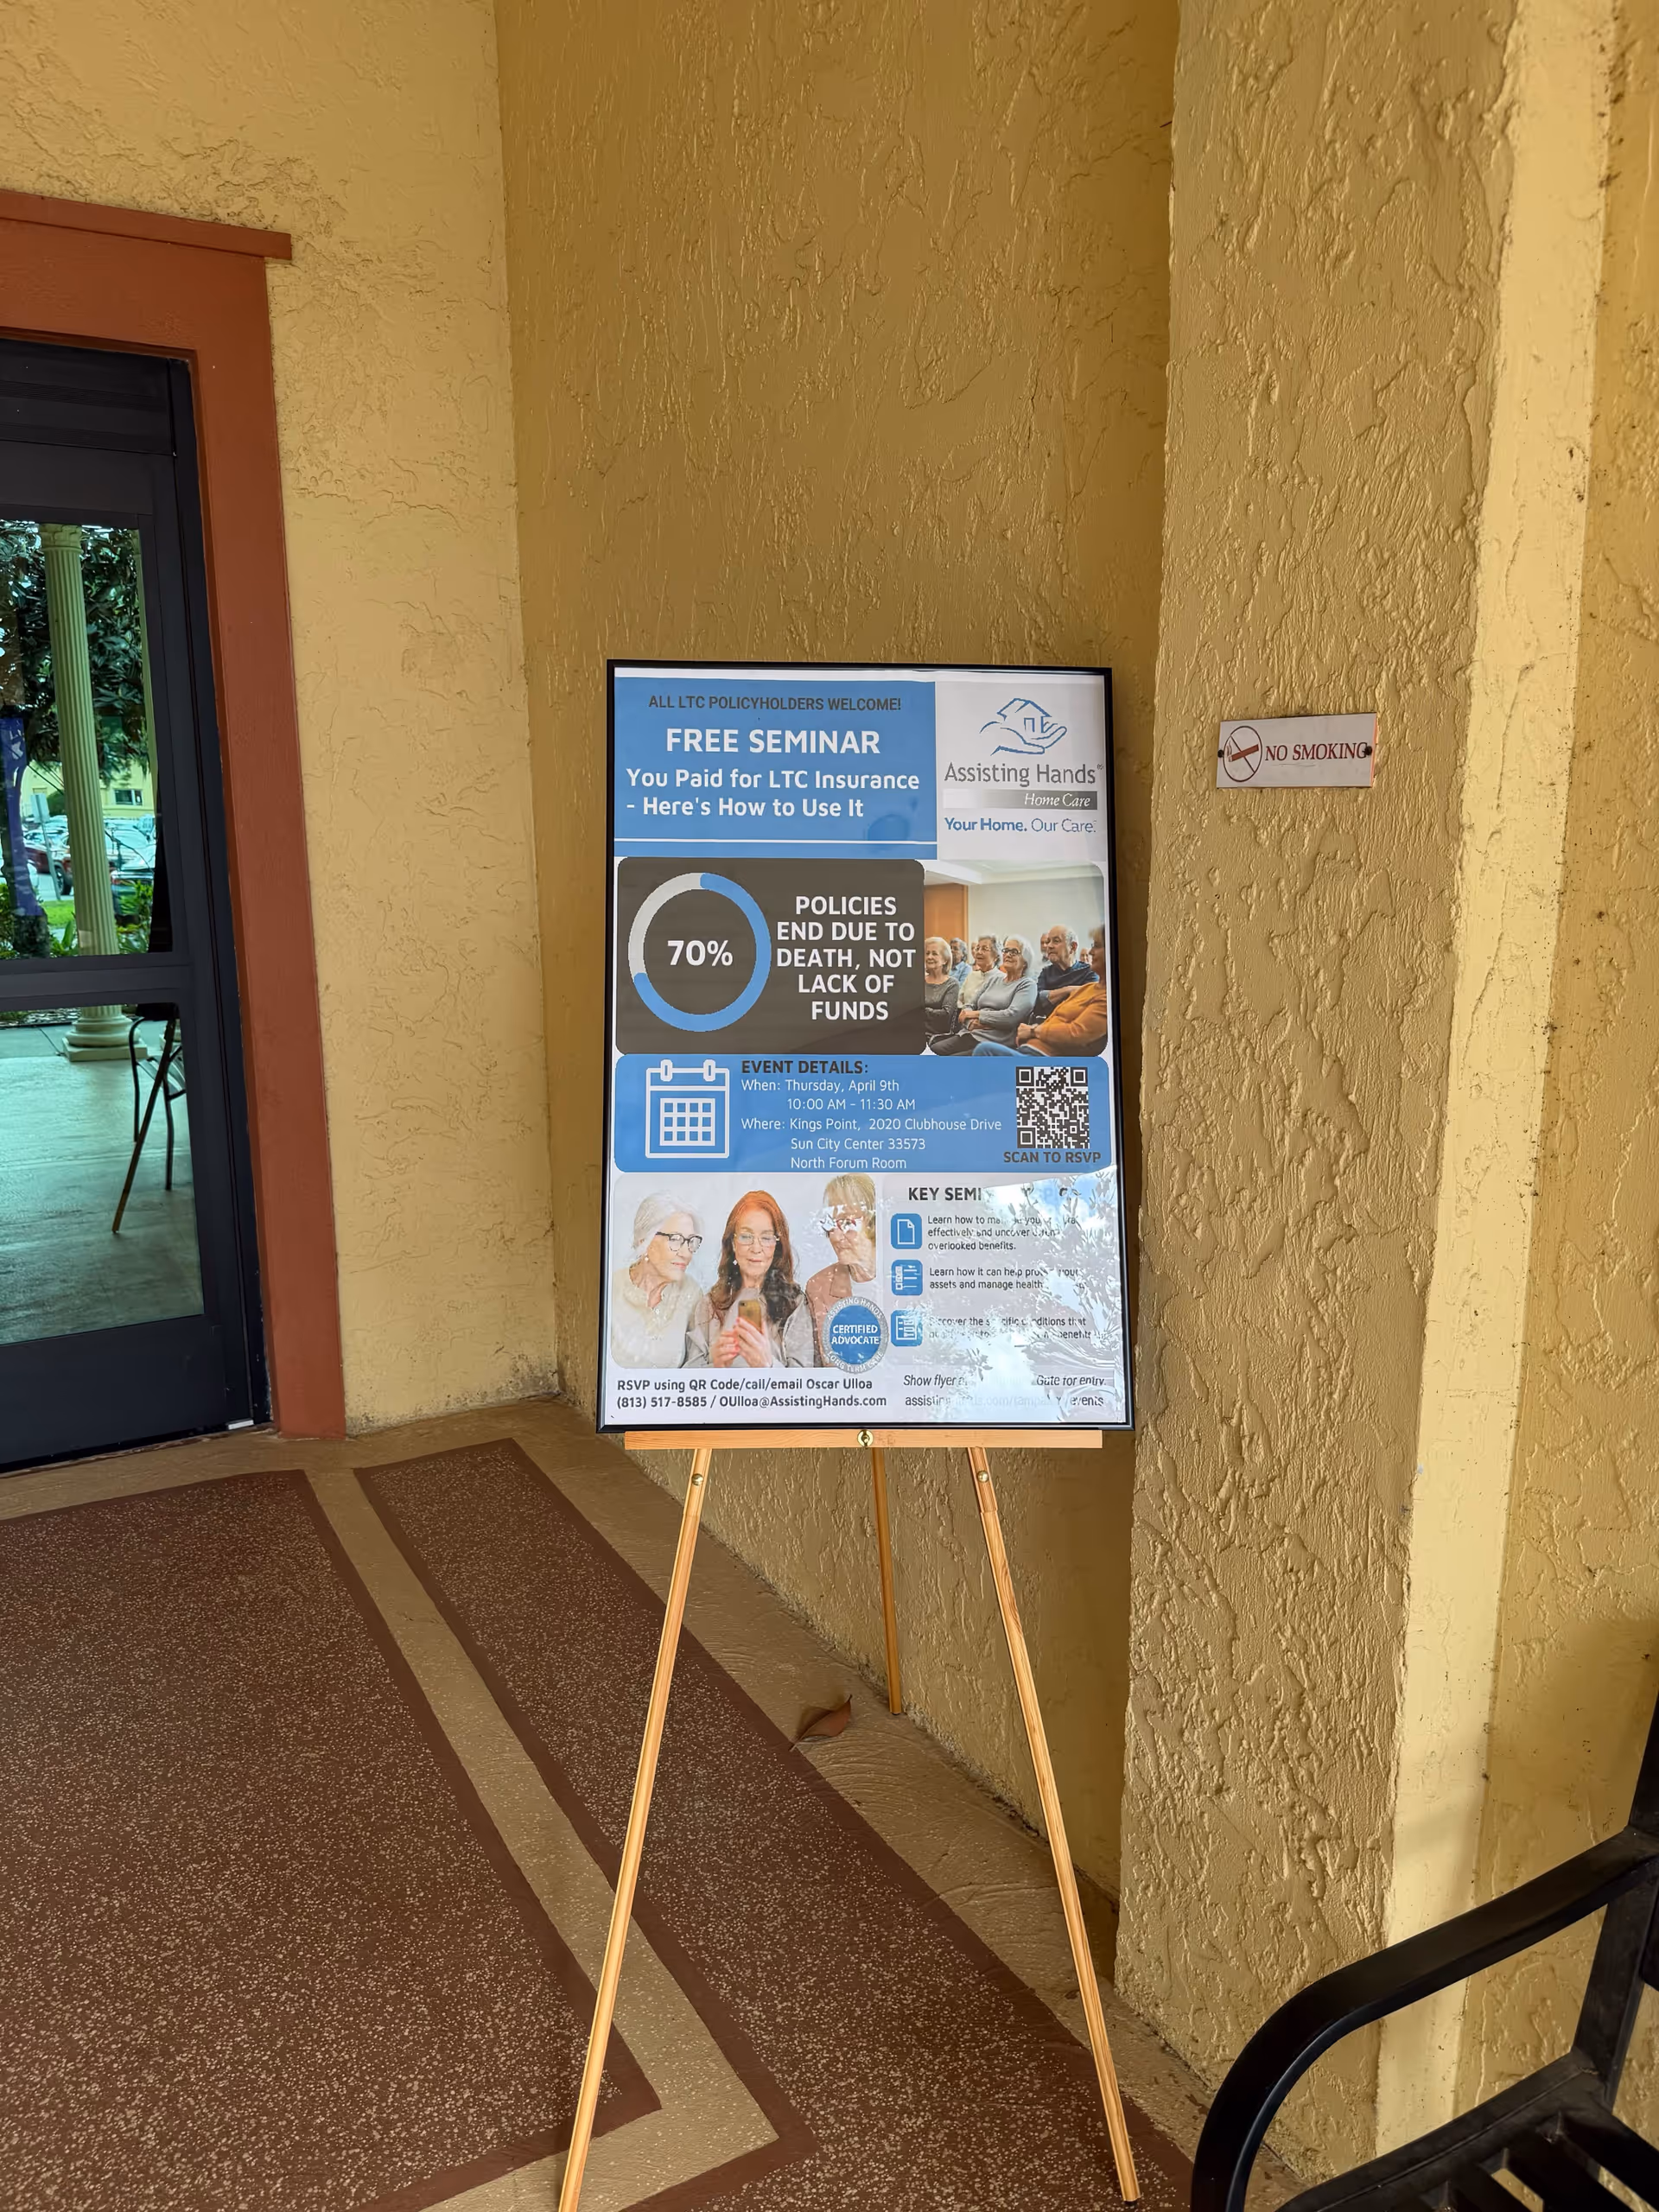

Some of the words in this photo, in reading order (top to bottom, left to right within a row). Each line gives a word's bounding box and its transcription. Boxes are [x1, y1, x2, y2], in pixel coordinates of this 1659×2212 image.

[649, 696, 678, 709] ALL
[681, 696, 705, 709] LTC
[709, 696, 824, 710] POLICYHOLDERS
[828, 697, 901, 711] WELCOME!
[666, 728, 739, 753] FREE
[749, 730, 880, 754] SEMINAR
[1265, 745, 1287, 760] NO
[1293, 742, 1368, 760] SMOKING
[626, 769, 670, 787] You
[676, 770, 723, 788] Paid
[729, 770, 761, 788] for
[768, 771, 808, 789] LTC
[816, 772, 919, 790] Insurance
[944, 762, 1030, 787] Assisting
[1025, 793, 1059, 806] Home
[1063, 793, 1090, 807] Care
[643, 798, 711, 816] Here's
[719, 798, 766, 817] How
[773, 800, 794, 817] to
[803, 799, 842, 817] Use
[849, 799, 863, 817] It
[944, 817, 977, 830] Your
[980, 818, 1027, 831] Home.
[1032, 818, 1058, 831] Our
[796, 896, 897, 915] POLICIES
[778, 922, 824, 941] END
[831, 923, 878, 941] DUE
[885, 923, 915, 941] TO
[667, 940, 734, 967] 70%
[778, 949, 861, 970] DEATH,
[869, 950, 916, 968] NOT
[798, 975, 857, 994] LACK
[865, 975, 894, 994] OF
[812, 1001, 888, 1020] FUNDS
[741, 1061, 793, 1073] EVENT
[798, 1061, 868, 1074] DETAILS:
[741, 1080, 780, 1091] When:
[785, 1080, 844, 1093] Thursday,
[849, 1081, 875, 1094] April
[880, 1081, 899, 1091] 9th
[787, 1099, 823, 1109] 10:00
[827, 1100, 846, 1109] AM
[861, 1100, 893, 1110] 11:30
[897, 1100, 915, 1110] AM
[741, 1119, 785, 1129] Where:
[790, 1119, 822, 1132] Kings
[826, 1119, 861, 1131] Point,
[869, 1119, 900, 1130] 2020
[905, 1119, 967, 1130] Clubhouse
[971, 1119, 1001, 1130] Drive
[791, 1139, 813, 1149] Sun
[817, 1139, 840, 1152] City
[844, 1139, 884, 1150] Center
[888, 1139, 925, 1149] 33573
[791, 1158, 825, 1168] North
[830, 1158, 868, 1168] Forum
[872, 1158, 906, 1168] Room
[1003, 1152, 1039, 1162] SCAN
[1043, 1152, 1060, 1162] TO
[1065, 1152, 1101, 1162] RSVP
[908, 1187, 940, 1200] KEY
[928, 1216, 952, 1224] Learn
[955, 1216, 973, 1224] how
[928, 1242, 976, 1250] overlooked
[979, 1242, 1015, 1250] benefits.
[930, 1281, 957, 1289] assets
[960, 1281, 976, 1289] and
[978, 1281, 1013, 1291] manage
[828, 1298, 859, 1320] ASSISTING
[861, 1300, 882, 1319] HANDS
[833, 1325, 878, 1333] CERTIFIED
[987, 1318, 1019, 1327] scific
[828, 1351, 844, 1369] LONG
[618, 1380, 650, 1390] RSVP
[654, 1379, 685, 1392] using
[690, 1379, 706, 1391] QR
[710, 1377, 802, 1390] Code/call/email
[806, 1378, 839, 1389] Oscar
[843, 1378, 872, 1389] Ulloa
[904, 1375, 931, 1386] Show
[934, 1375, 956, 1389] flyer
[617, 1397, 646, 1409] (813)
[651, 1397, 707, 1407] 517-8585
[710, 1396, 716, 1408] /
[720, 1395, 887, 1408] OUlloa@AssistingHands.com
